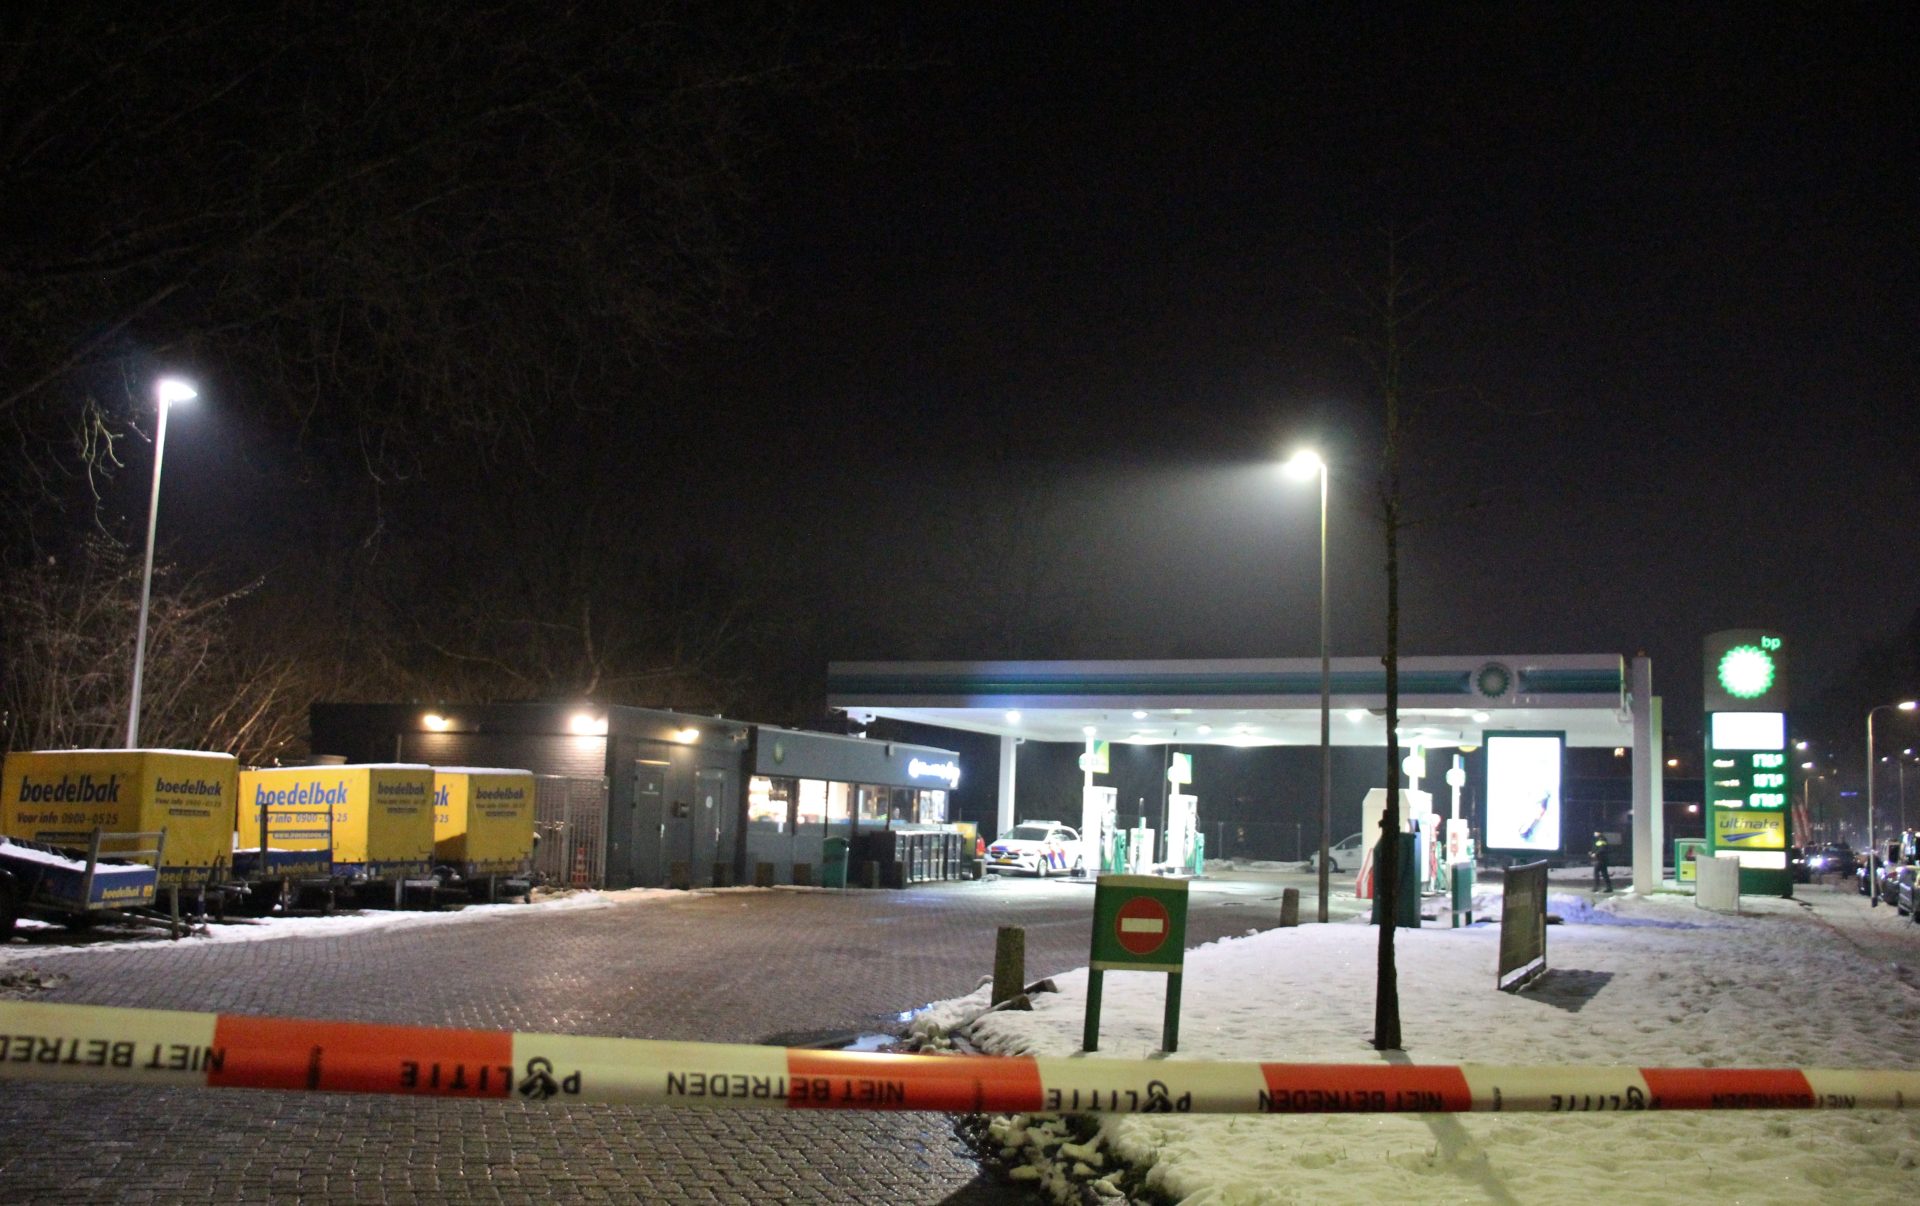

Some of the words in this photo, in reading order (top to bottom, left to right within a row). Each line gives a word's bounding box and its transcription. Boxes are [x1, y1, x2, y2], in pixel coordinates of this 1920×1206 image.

[1760, 635, 1781, 651] bp
[19, 773, 120, 802] boedelbak
[155, 777, 222, 796] boedelbak
[255, 781, 348, 805] boedelbak
[378, 781, 425, 796] boedelbak
[476, 786, 525, 800] boedelbak
[1720, 816, 1779, 830] ultimate
[145, 1044, 226, 1072] NIET
[666, 1072, 831, 1103] BETREDEN
[842, 1078, 905, 1104] NIET
[1258, 1089, 1387, 1111] BETREDEN
